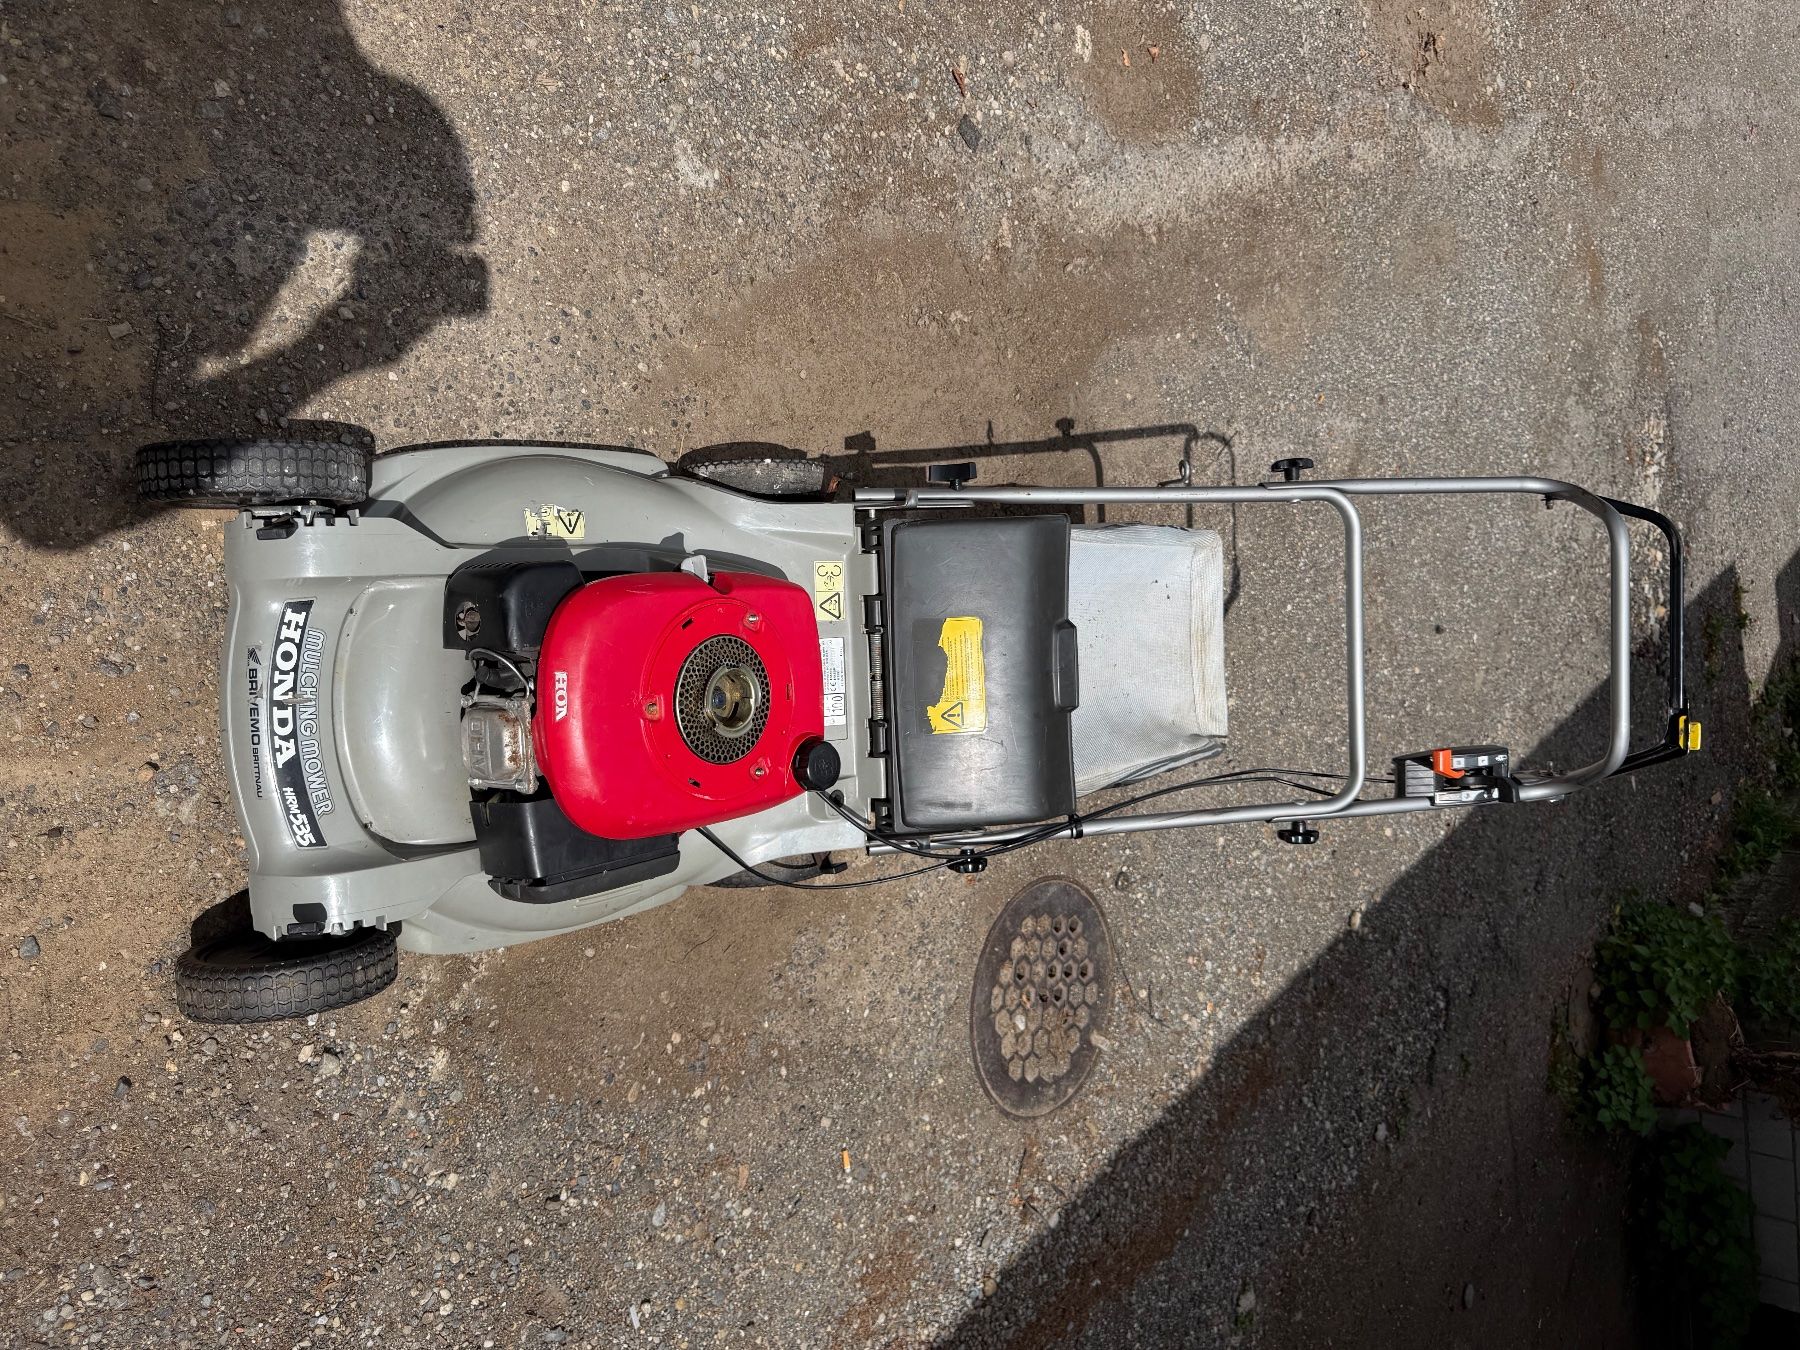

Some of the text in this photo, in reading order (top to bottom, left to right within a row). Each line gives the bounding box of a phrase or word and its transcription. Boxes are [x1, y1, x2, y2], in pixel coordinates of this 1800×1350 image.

[252, 748, 263, 798] BRITTNAU
[273, 608, 316, 847] HONDA HRM535
[299, 629, 333, 816] MULCHING MOWER
